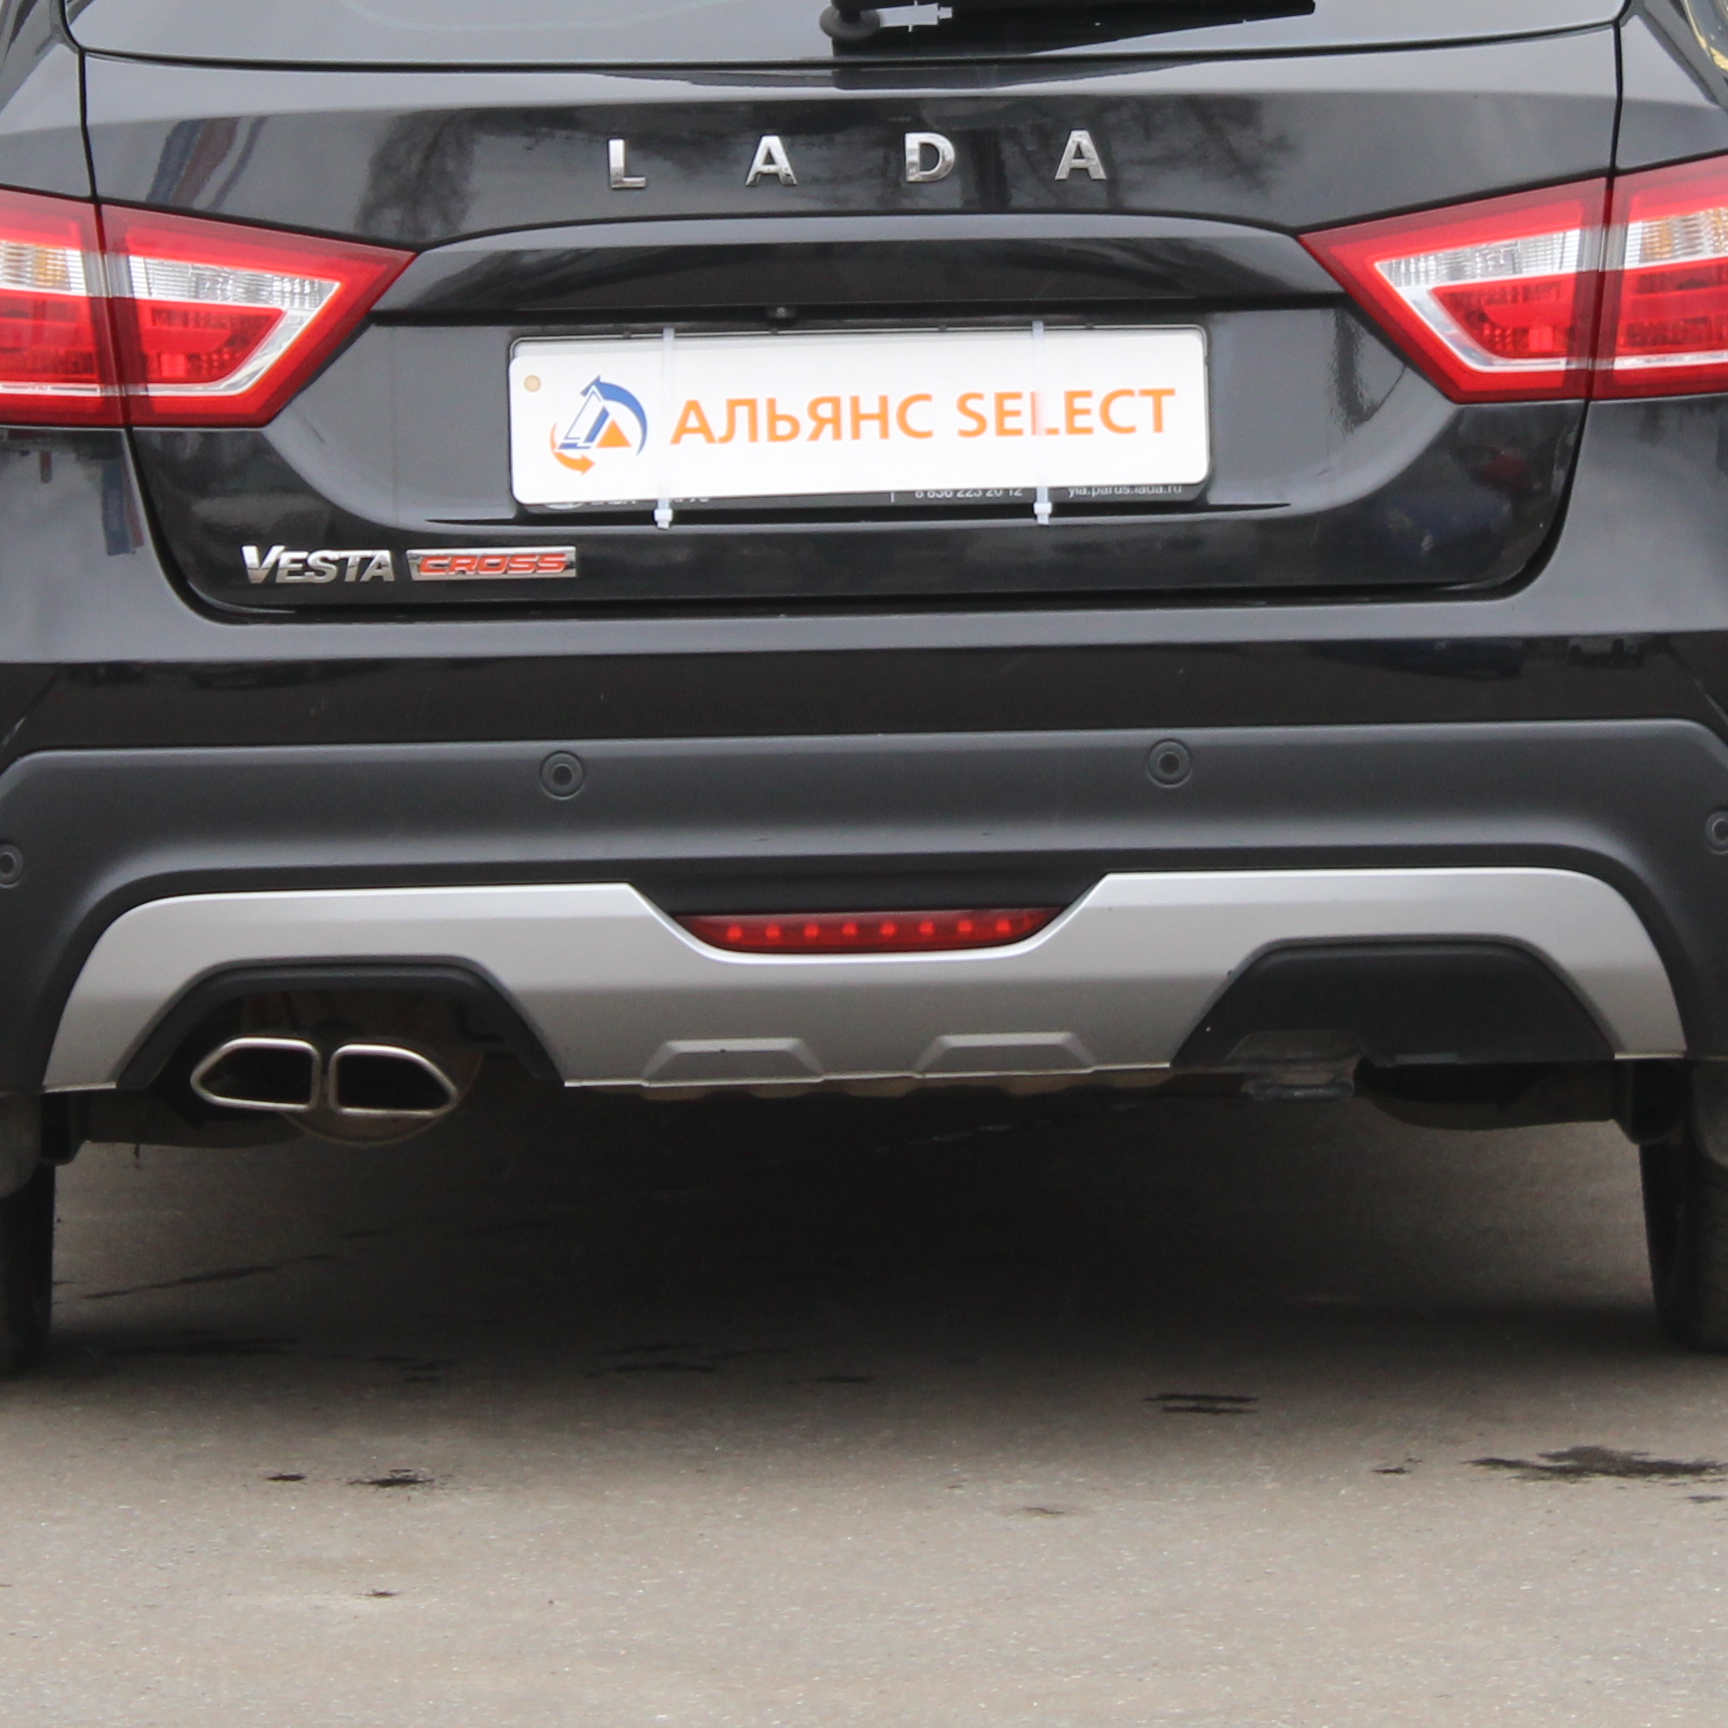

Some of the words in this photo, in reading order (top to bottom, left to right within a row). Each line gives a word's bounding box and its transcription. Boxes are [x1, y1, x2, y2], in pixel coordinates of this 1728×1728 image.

[607, 129, 1108, 190] LADA
[670, 393, 935, 445] АЛЬЯНС
[957, 387, 1177, 439] SELECT
[240, 545, 396, 584] VESTA
[416, 551, 570, 577] CROSS
